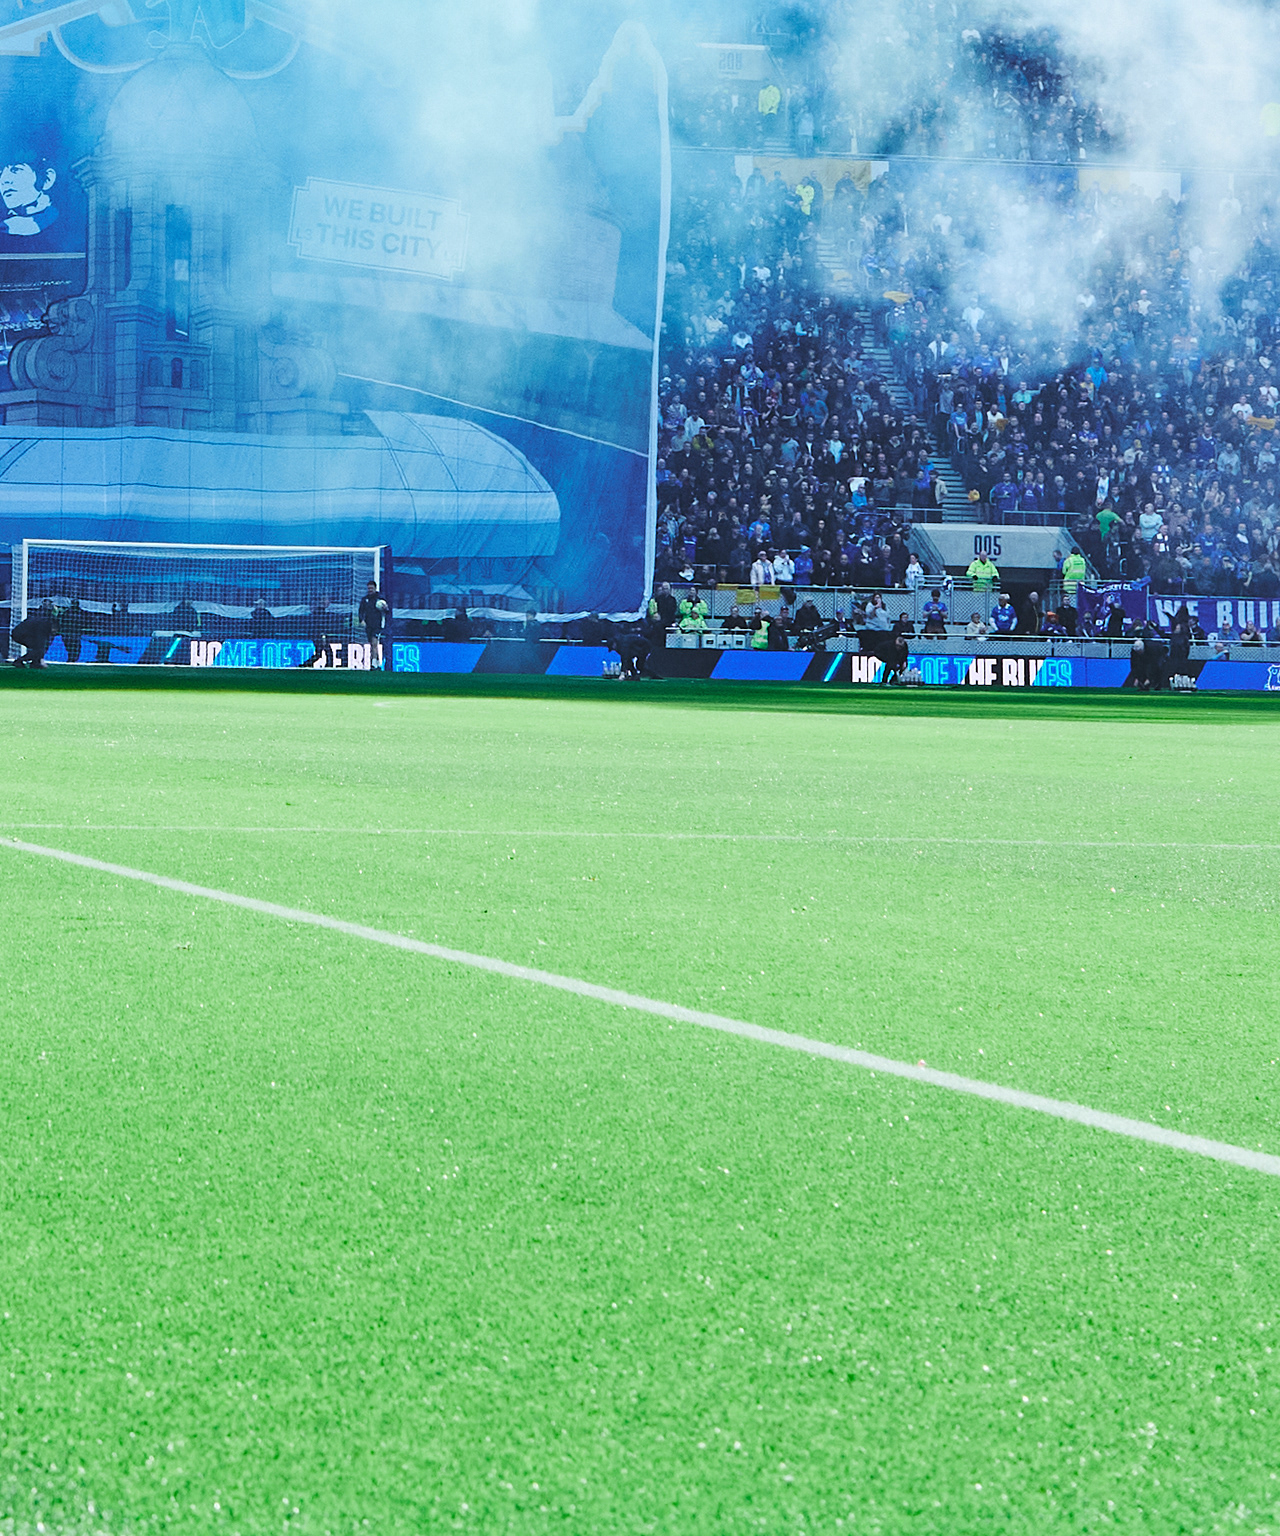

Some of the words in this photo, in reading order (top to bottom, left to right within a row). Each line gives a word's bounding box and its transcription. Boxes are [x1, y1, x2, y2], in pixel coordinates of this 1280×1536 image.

[324, 195, 363, 221] WE
[370, 202, 442, 230] BUILT
[317, 222, 375, 250] THIS
[381, 233, 442, 259] CITY
[974, 535, 1002, 555] 005
[348, 643, 420, 672] BLES
